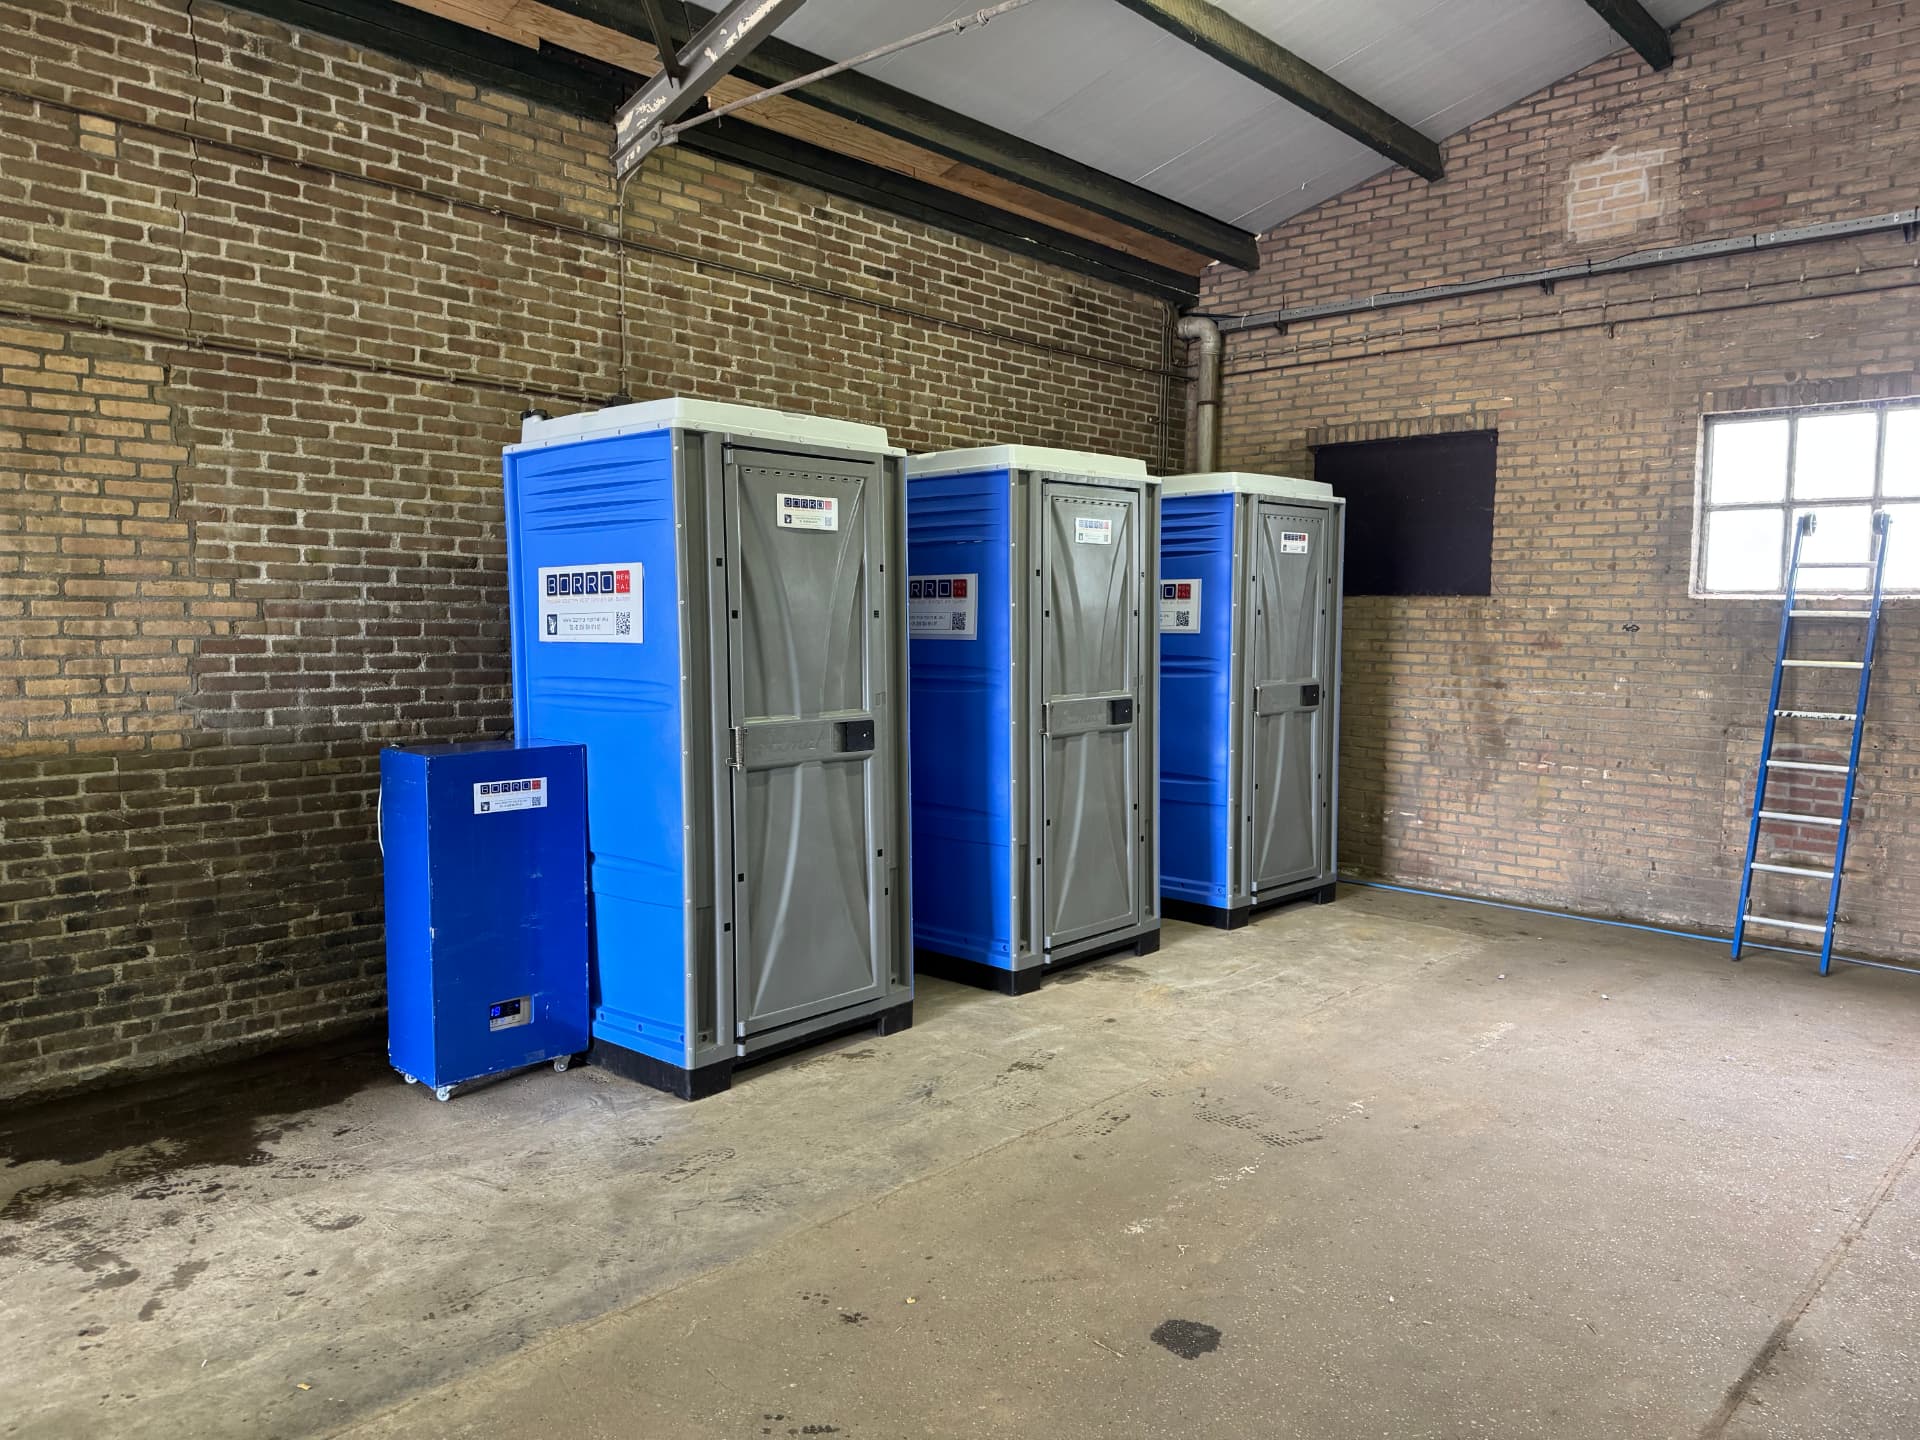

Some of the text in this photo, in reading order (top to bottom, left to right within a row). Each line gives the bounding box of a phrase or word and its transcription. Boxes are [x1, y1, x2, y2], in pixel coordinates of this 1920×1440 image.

[547, 573, 613, 594] BORRO
[910, 582, 950, 597] RRO
[481, 781, 531, 794] BORRO
